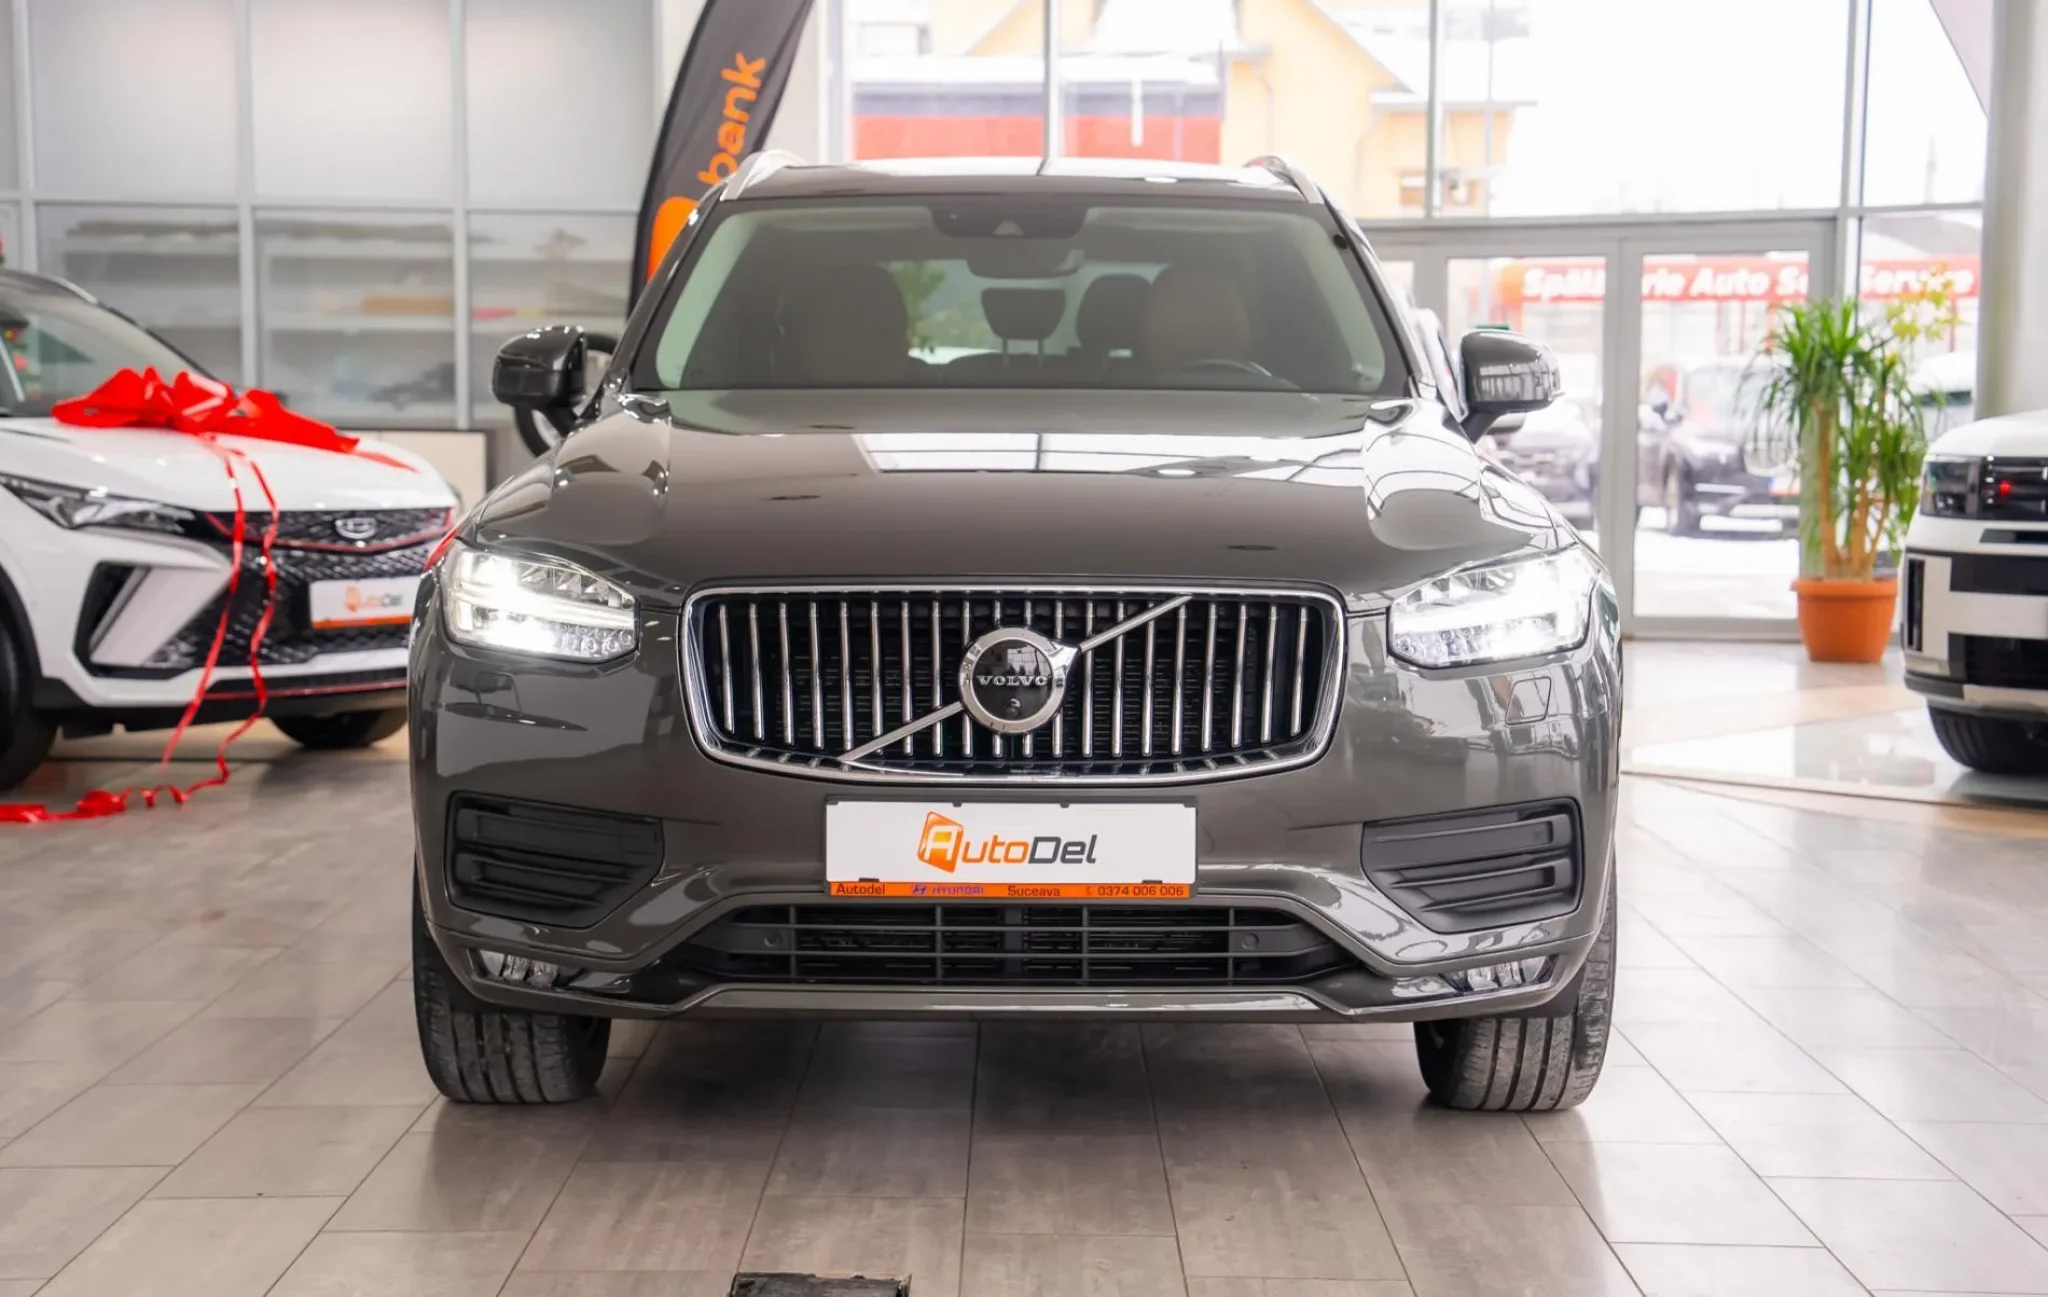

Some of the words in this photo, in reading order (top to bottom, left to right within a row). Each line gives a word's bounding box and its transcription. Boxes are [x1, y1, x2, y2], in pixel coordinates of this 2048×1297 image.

[697, 52, 767, 186] bank
[1690, 266, 1769, 296] Auto
[977, 675, 1048, 686] VOLVO
[920, 822, 1098, 868] AutoDel
[836, 883, 886, 895] Autodel
[932, 886, 984, 895] HYUNDAI
[1007, 885, 1061, 897] Suceava
[1099, 885, 1129, 897] 0374
